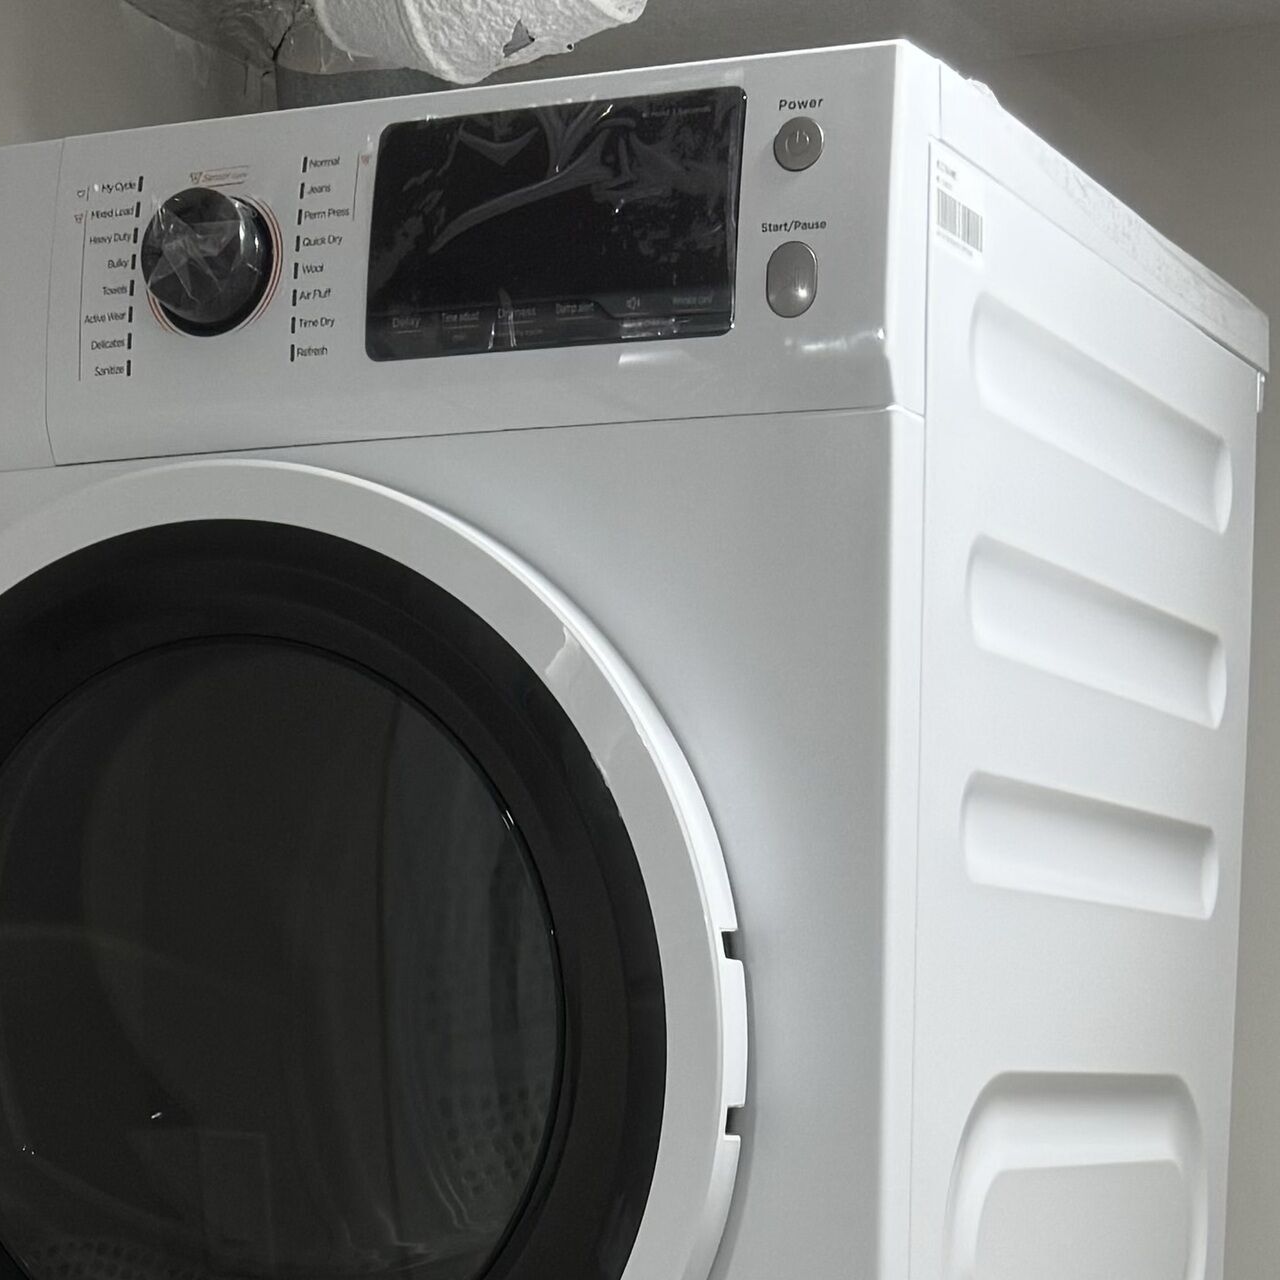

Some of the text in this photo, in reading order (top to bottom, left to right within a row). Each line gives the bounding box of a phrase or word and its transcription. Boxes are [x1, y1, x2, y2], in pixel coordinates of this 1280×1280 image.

[779, 98, 824, 111] Power
[309, 156, 340, 168] Normal
[308, 184, 331, 194] Jeans
[304, 207, 350, 220] Perm Press
[761, 220, 827, 233] Start/Pause
[303, 234, 343, 247] Quick Dry
[302, 263, 324, 274] Wool
[299, 316, 335, 328] Time Dry
